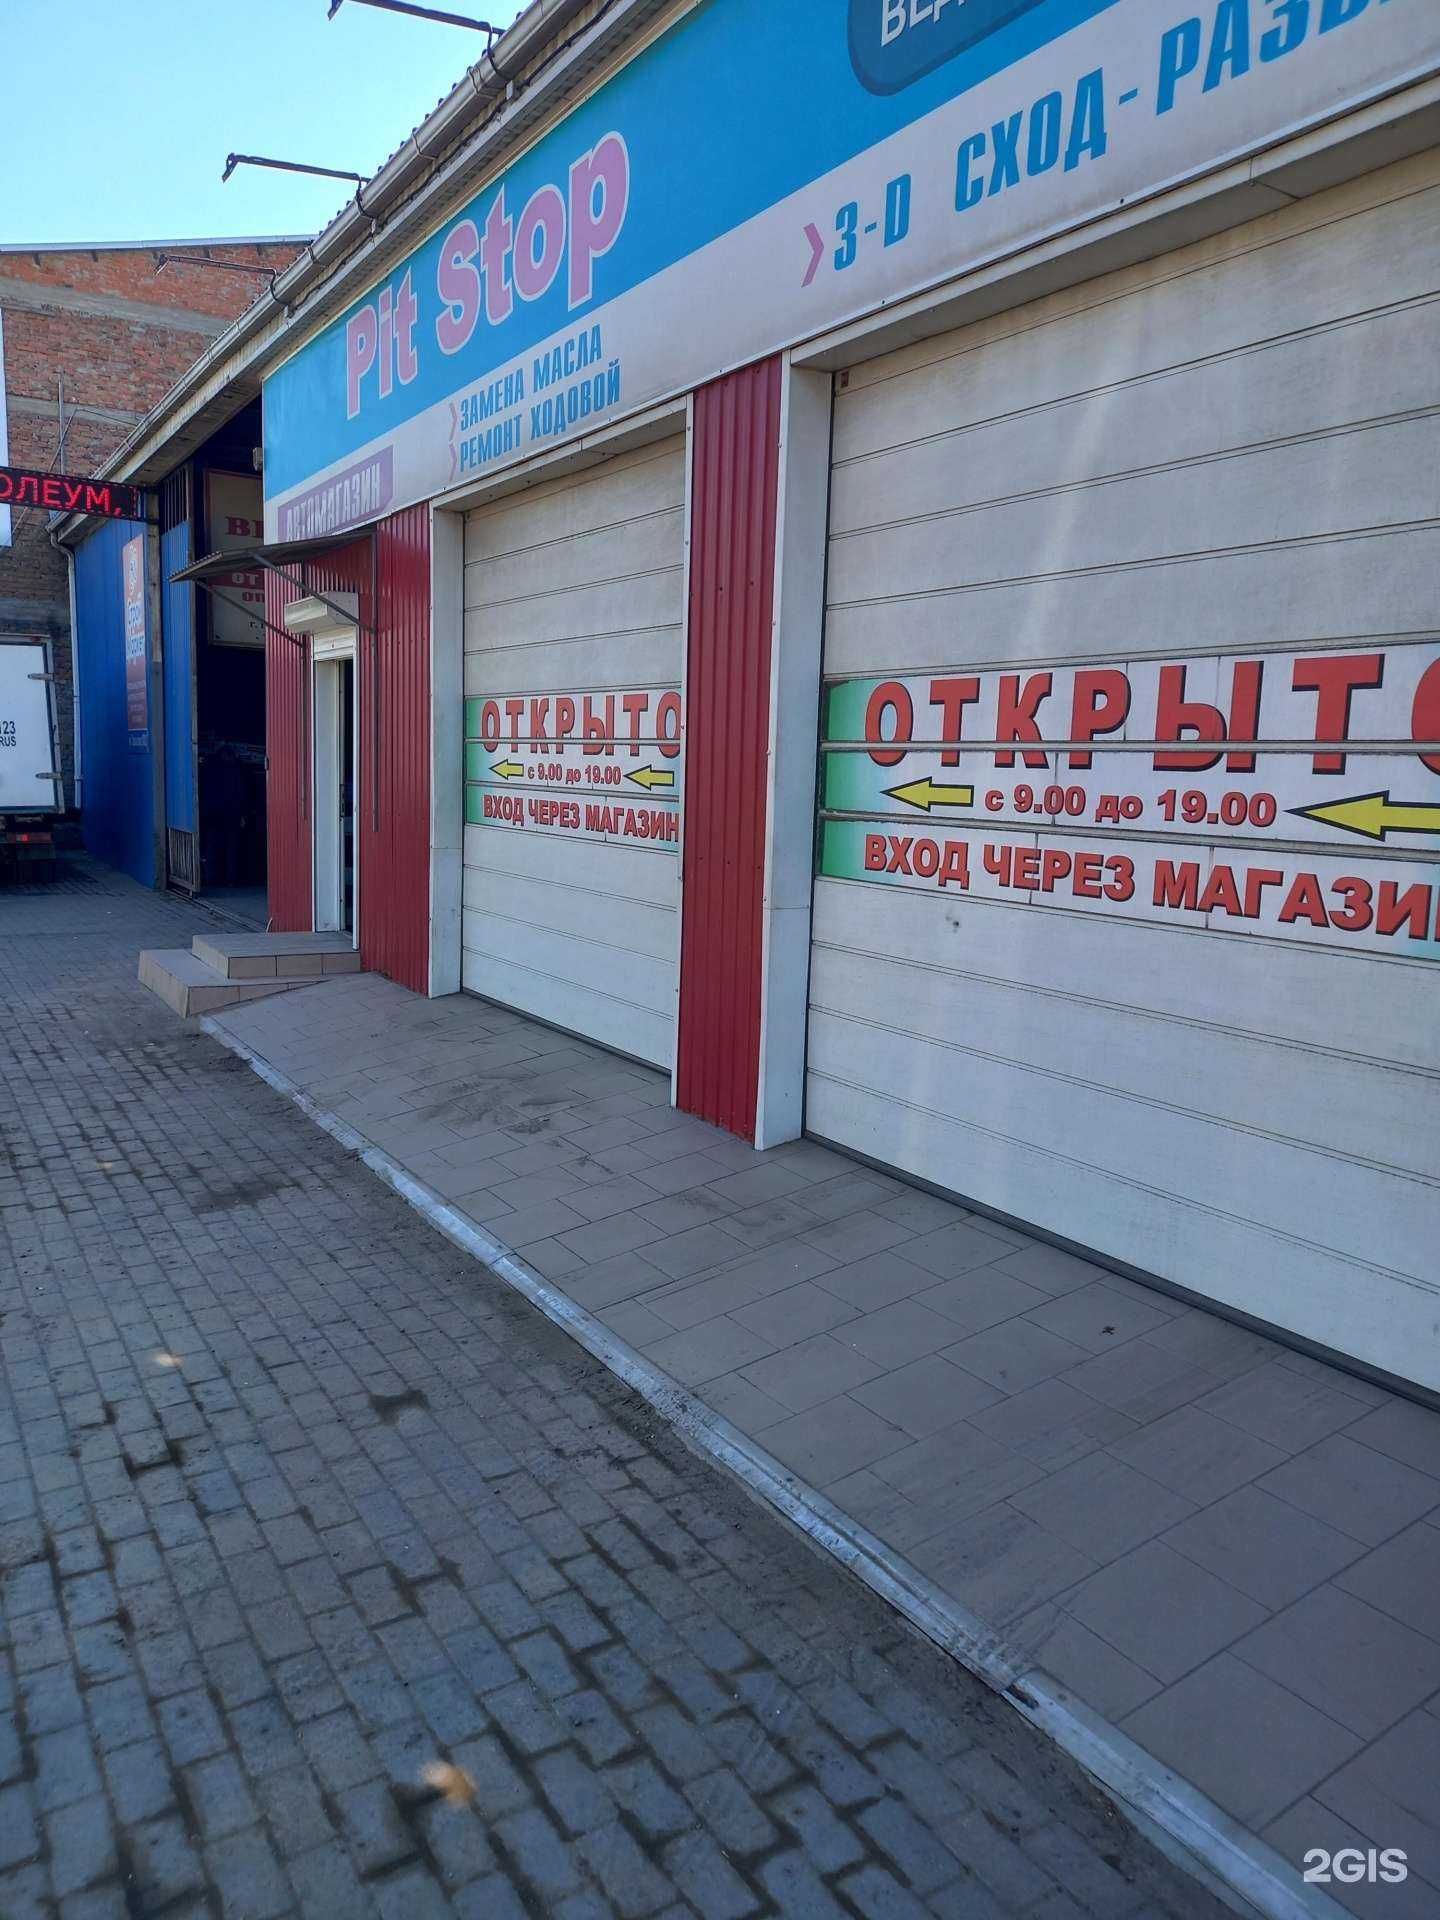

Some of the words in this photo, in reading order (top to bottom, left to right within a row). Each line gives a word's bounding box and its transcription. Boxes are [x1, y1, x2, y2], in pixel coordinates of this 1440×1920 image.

[345, 265, 418, 420] Pit
[435, 130, 631, 356] Stop
[459, 413, 523, 473] РЕМОНТ
[530, 358, 621, 441] ХОДОВОЙ
[460, 367, 525, 432] ЗАМЕНА
[532, 323, 602, 393] МАСЛА
[481, 691, 682, 759] ОТКРЫТО
[538, 762, 563, 783] 9.00
[565, 769, 581, 785] до
[584, 764, 622, 785] 19.00
[985, 789, 1004, 811] с
[1013, 784, 1087, 816] 9.00
[1095, 794, 1144, 824] до
[1157, 789, 1278, 828] 19.00
[483, 794, 525, 827] ВХОД
[528, 798, 581, 829] ЧЕРЕЗ
[585, 803, 680, 843] МАГАЗИН
[864, 833, 970, 890] ВХОД
[982, 844, 1136, 903] ЧЕРЕЗ
[1152, 859, 1440, 943] МАГАЗИ
